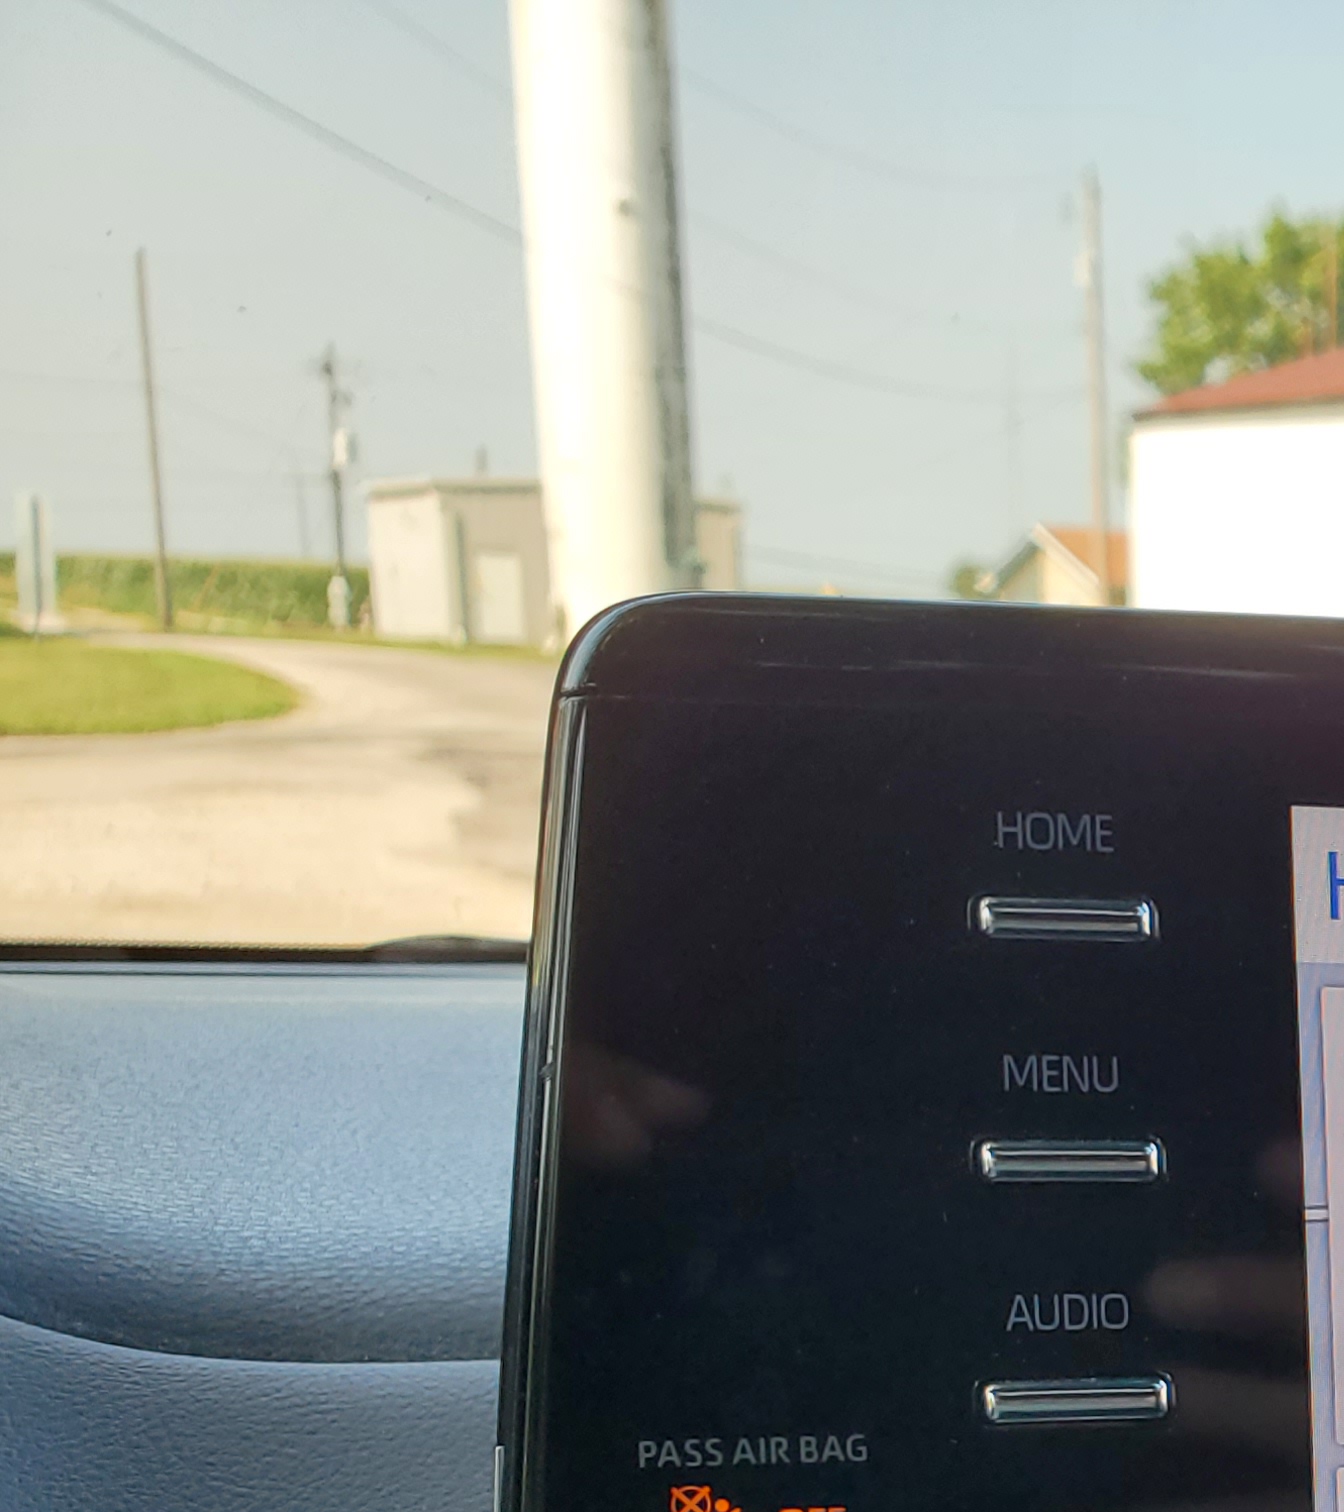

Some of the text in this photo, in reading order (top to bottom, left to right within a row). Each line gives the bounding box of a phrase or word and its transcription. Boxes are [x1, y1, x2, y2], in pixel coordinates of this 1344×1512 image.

[996, 812, 1115, 853] HOME
[1002, 1055, 1119, 1093] MENU
[1006, 1292, 1130, 1332] AUDIO
[637, 1434, 869, 1469] PASS AIR BAG
